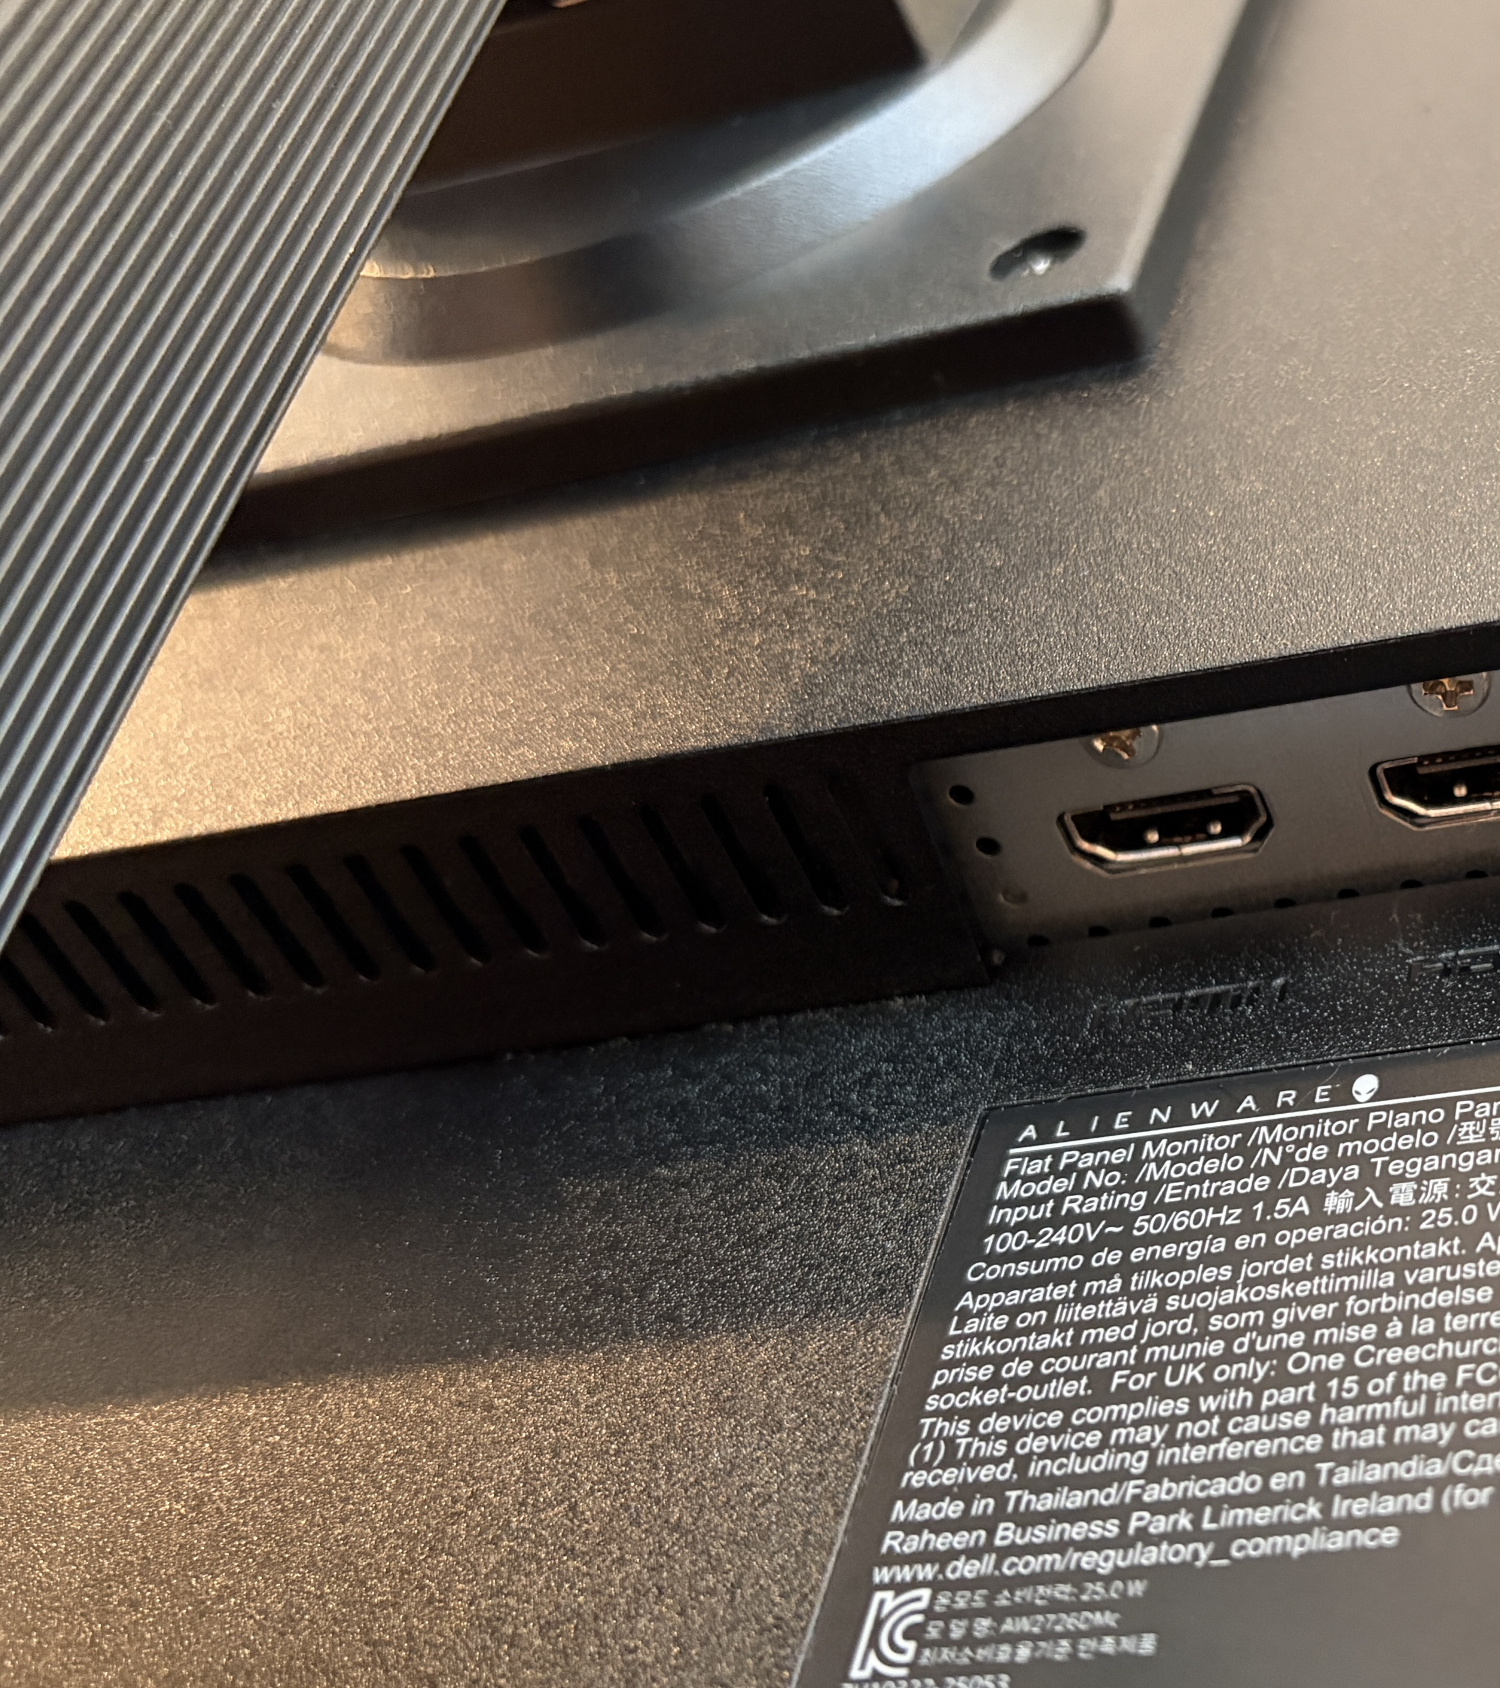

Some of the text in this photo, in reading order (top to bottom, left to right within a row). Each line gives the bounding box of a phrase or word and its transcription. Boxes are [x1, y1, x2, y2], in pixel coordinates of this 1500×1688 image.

[995, 1171, 1077, 1201] Model
[1134, 1152, 1244, 1186] /Modelo
[1337, 1128, 1439, 1158] modelo
[1003, 1154, 1053, 1177] Flat
[1058, 1142, 1135, 1170] Panel
[1141, 1132, 1243, 1160] Monitor
[1246, 1118, 1360, 1150] /Monitor
[1367, 1107, 1445, 1132] Plano
[966, 1254, 1084, 1282] Consumo
[1090, 1246, 1123, 1268] de
[1129, 1234, 1227, 1263] energía
[1234, 1232, 1267, 1250] en
[1274, 1214, 1411, 1249] operación:
[1419, 1204, 1478, 1230] 25.0
[988, 1198, 1055, 1227] Input
[1060, 1189, 1148, 1216] Rating
[1132, 1204, 1243, 1237] 50/60Hz
[1252, 1195, 1310, 1222] 1.5A
[948, 1309, 1010, 1336] Laite
[1015, 1310, 1048, 1328] on
[1053, 1292, 1158, 1324] liitettävä
[1165, 1268, 1395, 1316] suojakoskettimilla
[953, 1279, 1078, 1314] Apparatet
[1082, 1272, 1123, 1297] må
[1125, 1263, 1233, 1298] tilkoples
[1237, 1252, 1314, 1286] jordet
[1320, 1236, 1466, 1270] stikkontakt.
[931, 1362, 995, 1390] prise
[1000, 1356, 1034, 1379] de
[1040, 1344, 1138, 1375] courant
[1144, 1335, 1225, 1364] munie
[1232, 1330, 1306, 1354] d'une
[1313, 1321, 1378, 1346] mise
[1385, 1316, 1403, 1339] à
[1410, 1314, 1436, 1336] la
[940, 1327, 1075, 1361] stikkontakt
[1080, 1318, 1139, 1345] med
[1141, 1312, 1199, 1345] jord,
[1208, 1310, 1265, 1332] som
[1271, 1301, 1340, 1330] giver
[1345, 1284, 1494, 1317] forbindelse
[924, 1375, 1093, 1412] socket-outlet.
[1110, 1369, 1158, 1393] For
[1164, 1361, 1207, 1387] UK
[1213, 1356, 1278, 1384] only:
[1287, 1351, 1346, 1375] One
[880, 1528, 987, 1554] Raheen
[993, 1518, 1120, 1547] Business
[1127, 1507, 1194, 1536] Park
[1201, 1496, 1322, 1530] Limerick
[1331, 1486, 1434, 1518] Ireland
[1441, 1482, 1494, 1514] (for
[890, 1496, 965, 1522] Made
[970, 1493, 995, 1516] in
[1269, 1470, 1306, 1492] en
